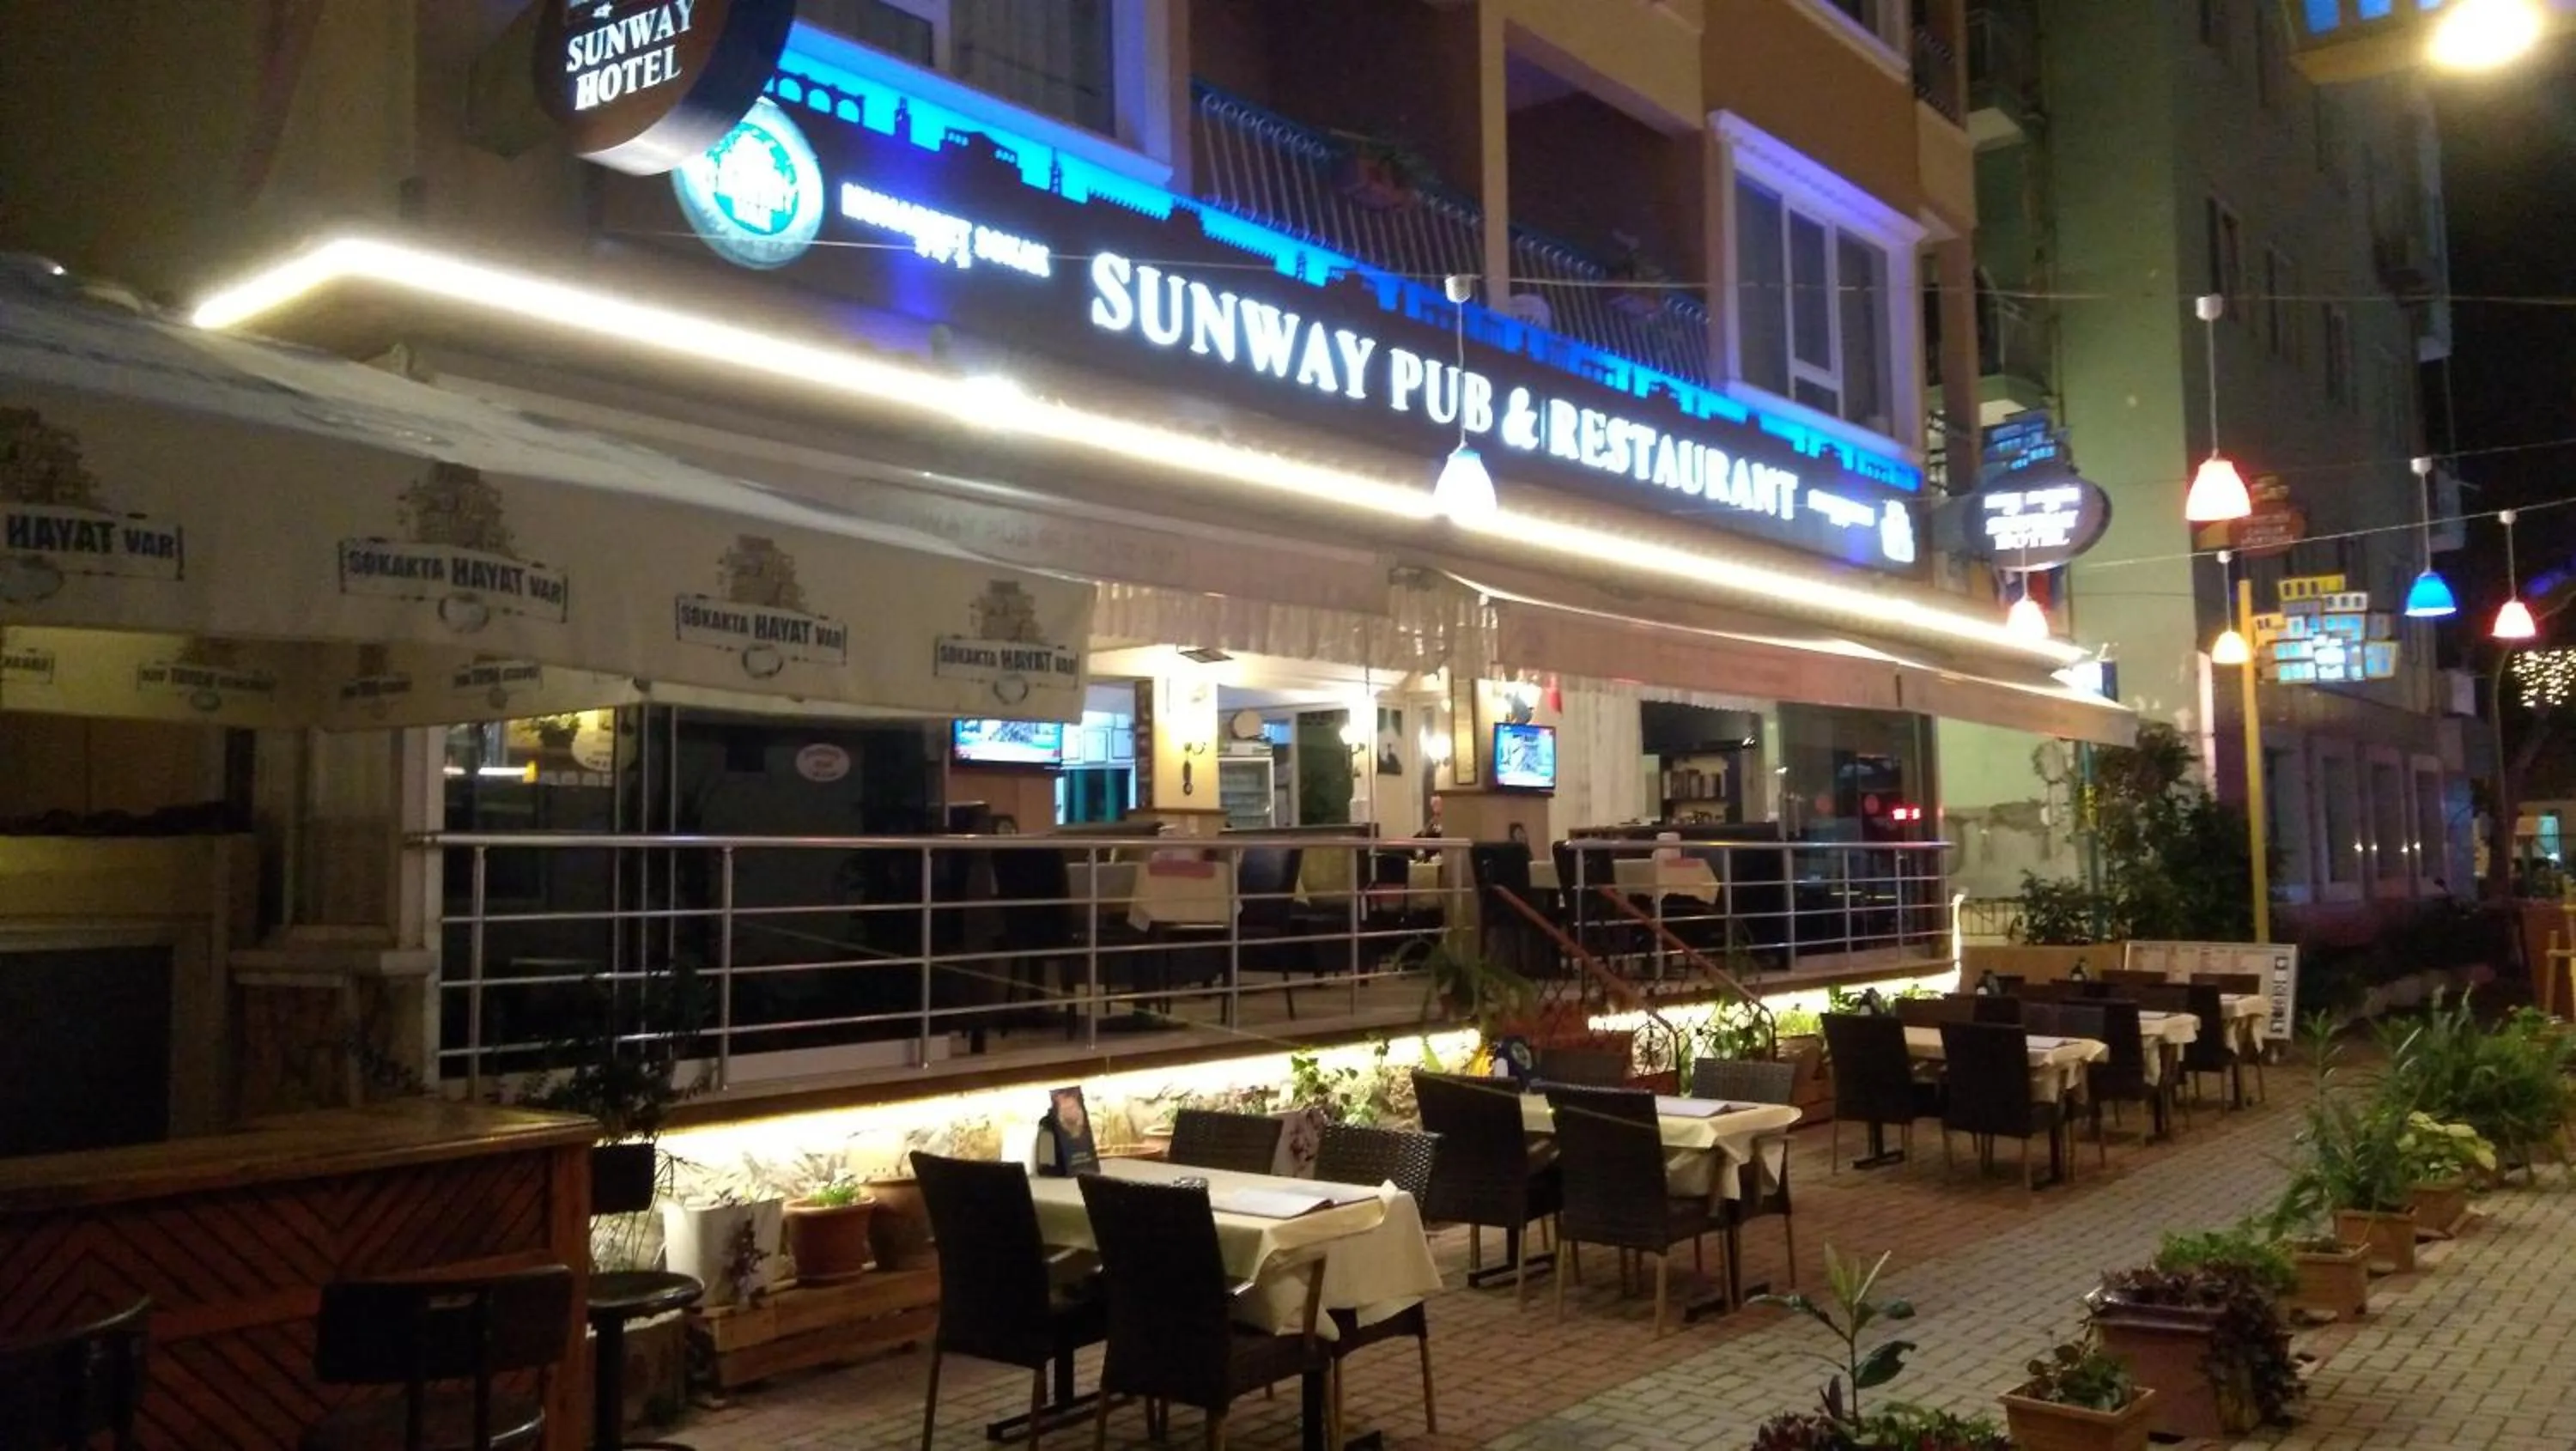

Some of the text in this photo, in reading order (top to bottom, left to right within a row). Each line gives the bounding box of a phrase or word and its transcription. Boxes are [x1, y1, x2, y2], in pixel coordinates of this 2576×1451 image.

[566, 0, 694, 72] SUNWAY
[574, 45, 683, 111] HOTEL
[1091, 252, 1799, 520] SUNWAY PUB & RESTAURANT
[8, 515, 174, 558] HAYAT VAR
[348, 550, 562, 604] SOKAKTA HAYAT VAR
[681, 604, 842, 649] SOKAKTA HAYAT VAR
[1000, 649, 1052, 672] HAYAT
